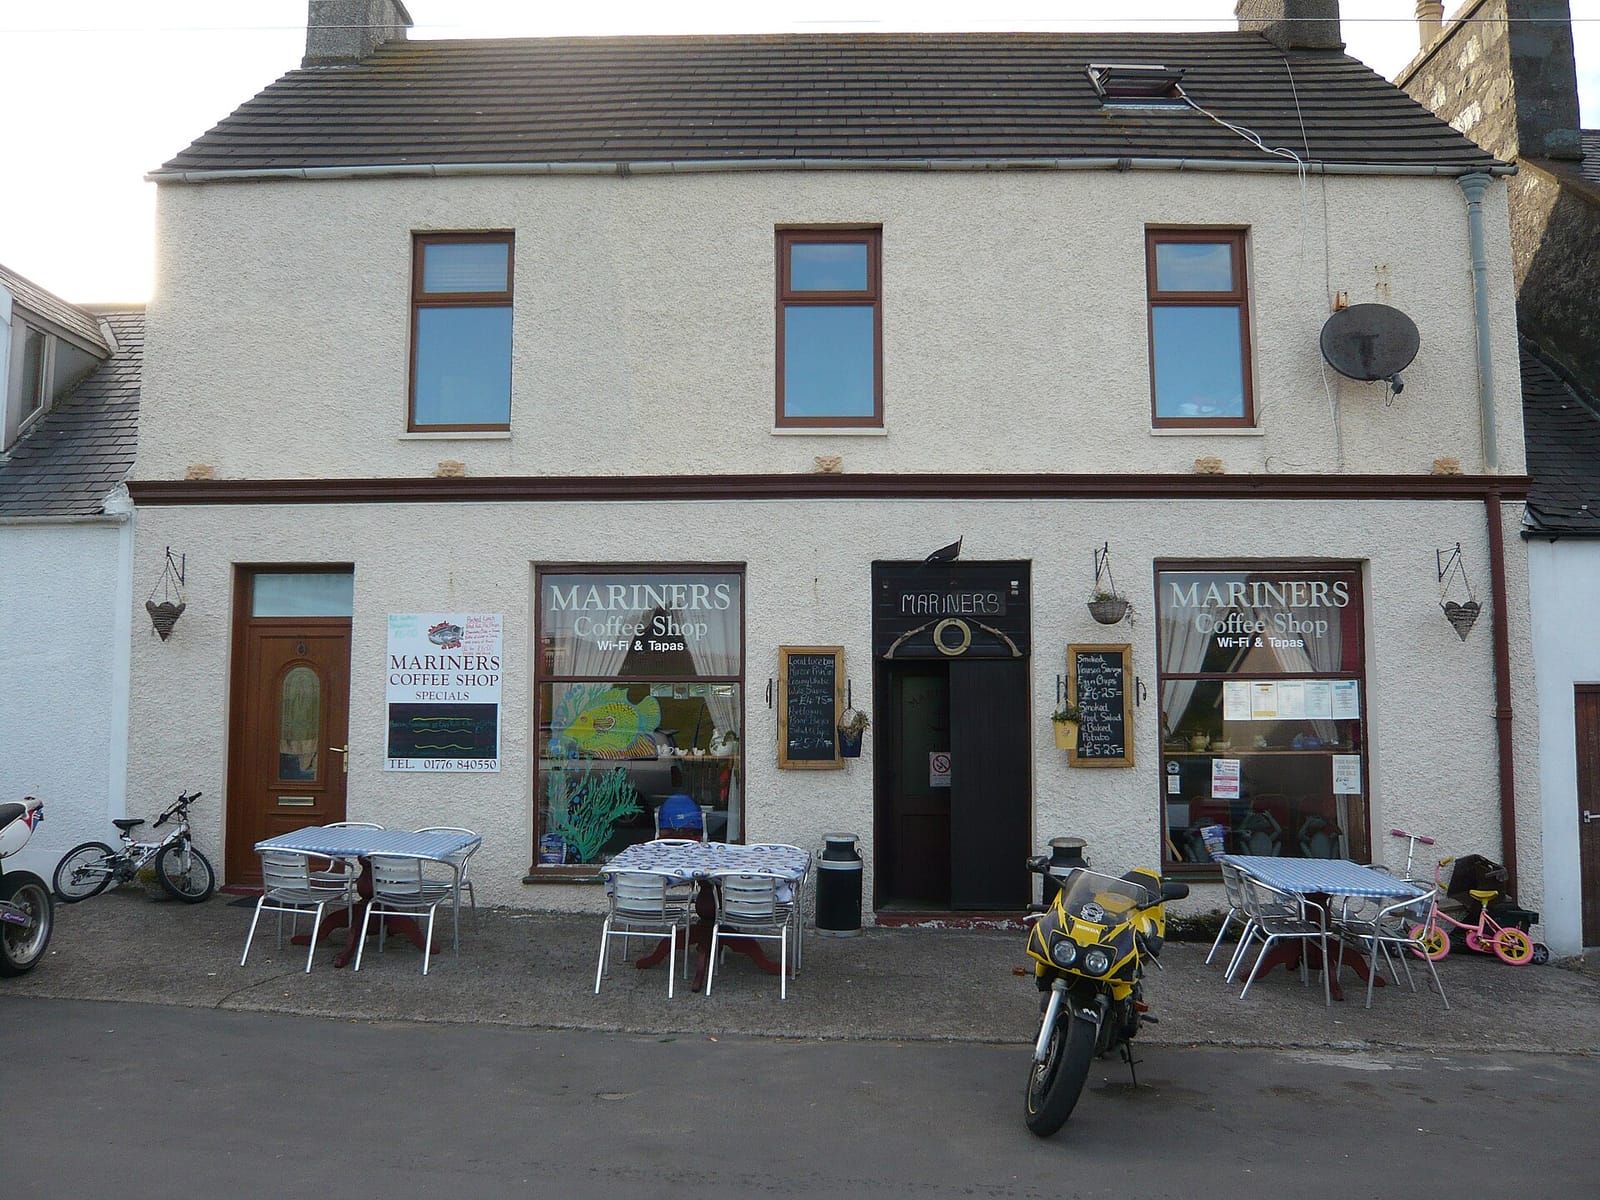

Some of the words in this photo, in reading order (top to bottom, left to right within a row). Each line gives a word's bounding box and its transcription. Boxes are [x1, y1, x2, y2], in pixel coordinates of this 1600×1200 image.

[550, 584, 731, 611] MARINERS
[1170, 581, 1350, 608] MARINERS
[902, 593, 1000, 614] MARINERS
[574, 616, 645, 637] Coffee
[653, 616, 708, 641] Shop
[1195, 613, 1266, 634] Coffee
[1274, 613, 1328, 638] Shop
[597, 640, 629, 651] Wi-Fi
[634, 641, 644, 651] &
[648, 640, 684, 653] Tapas
[1217, 637, 1250, 648] Wi-Fi
[1254, 637, 1264, 648] &
[1268, 637, 1304, 649] Tapas
[390, 654, 500, 671] MARINERS
[1077, 654, 1106, 663] Smoked
[389, 673, 450, 686] COFFEE
[456, 674, 499, 687] SHOP
[415, 691, 470, 701] SPECIALS
[1079, 701, 1109, 712] Smoked
[390, 759, 415, 769] TEL.
[423, 760, 453, 770] 01776
[456, 760, 497, 770] 840550
